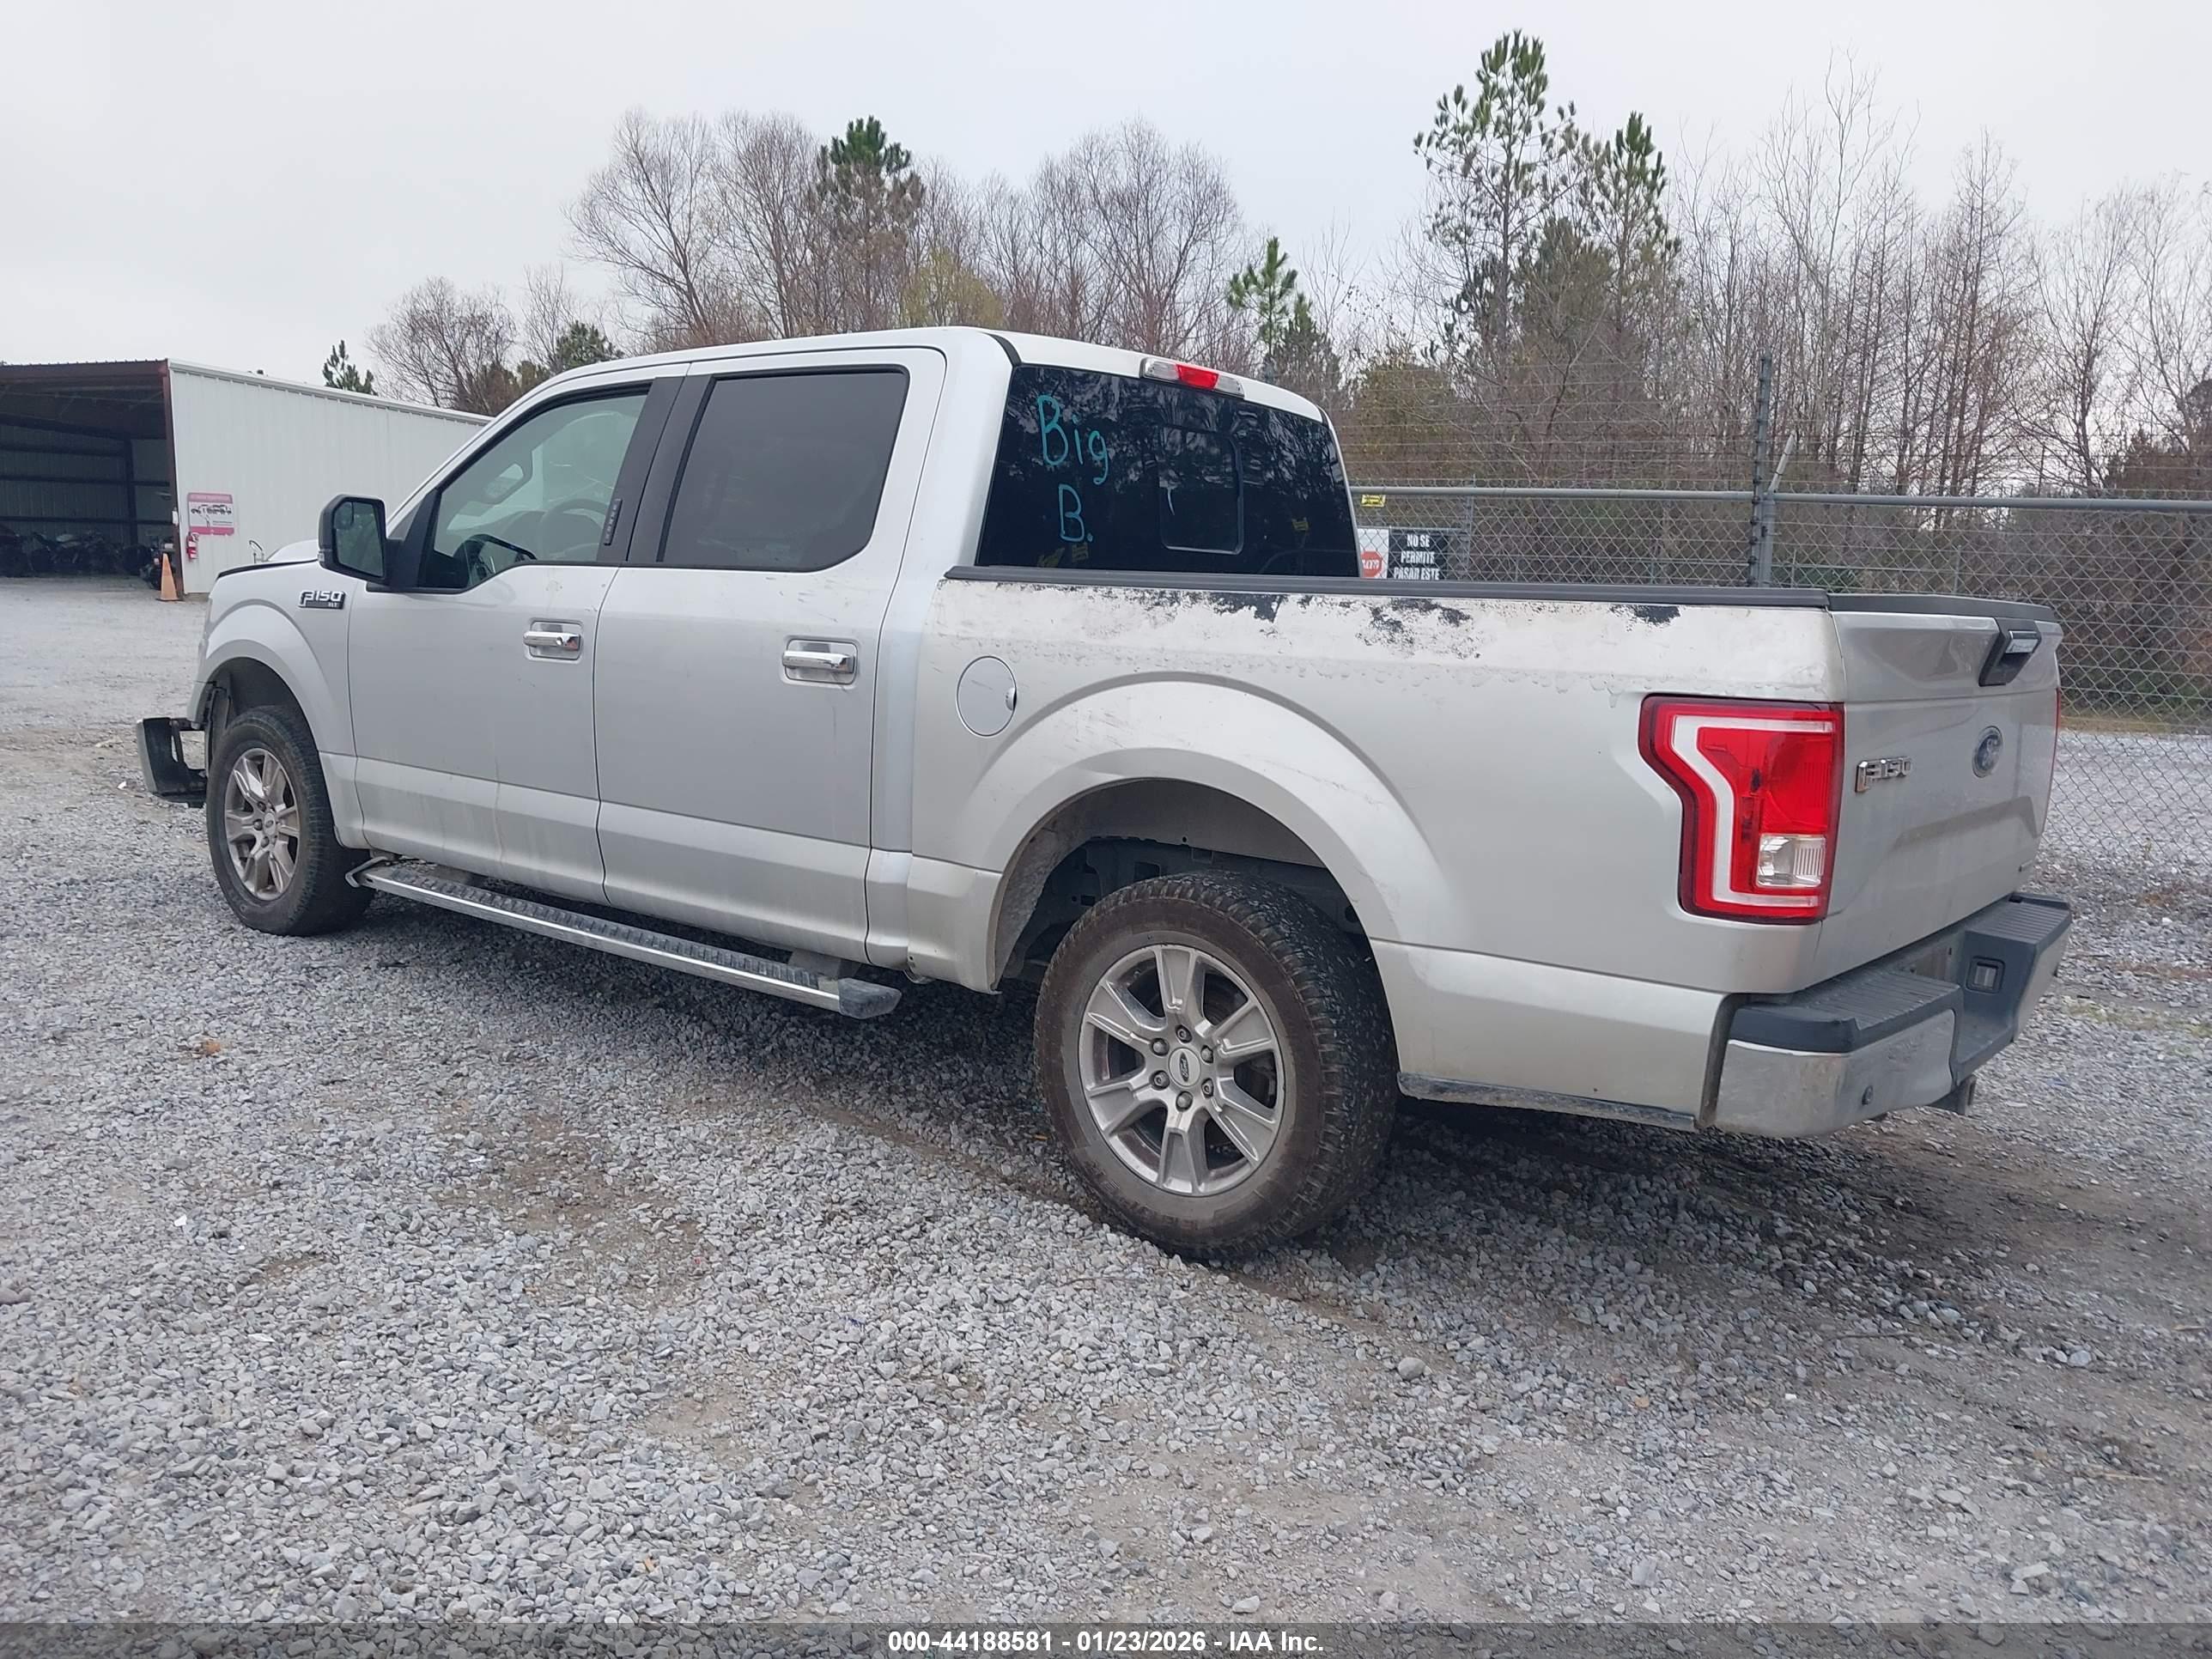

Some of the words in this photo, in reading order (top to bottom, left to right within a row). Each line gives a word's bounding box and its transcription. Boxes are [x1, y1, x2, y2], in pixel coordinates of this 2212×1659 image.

[1036, 394, 1109, 485] Big
[1058, 483, 1094, 543] B.
[1407, 534, 1419, 547] NO
[1420, 534, 1430, 547] SE
[1394, 568, 1419, 580] PASAR
[1420, 568, 1440, 580] ESTE
